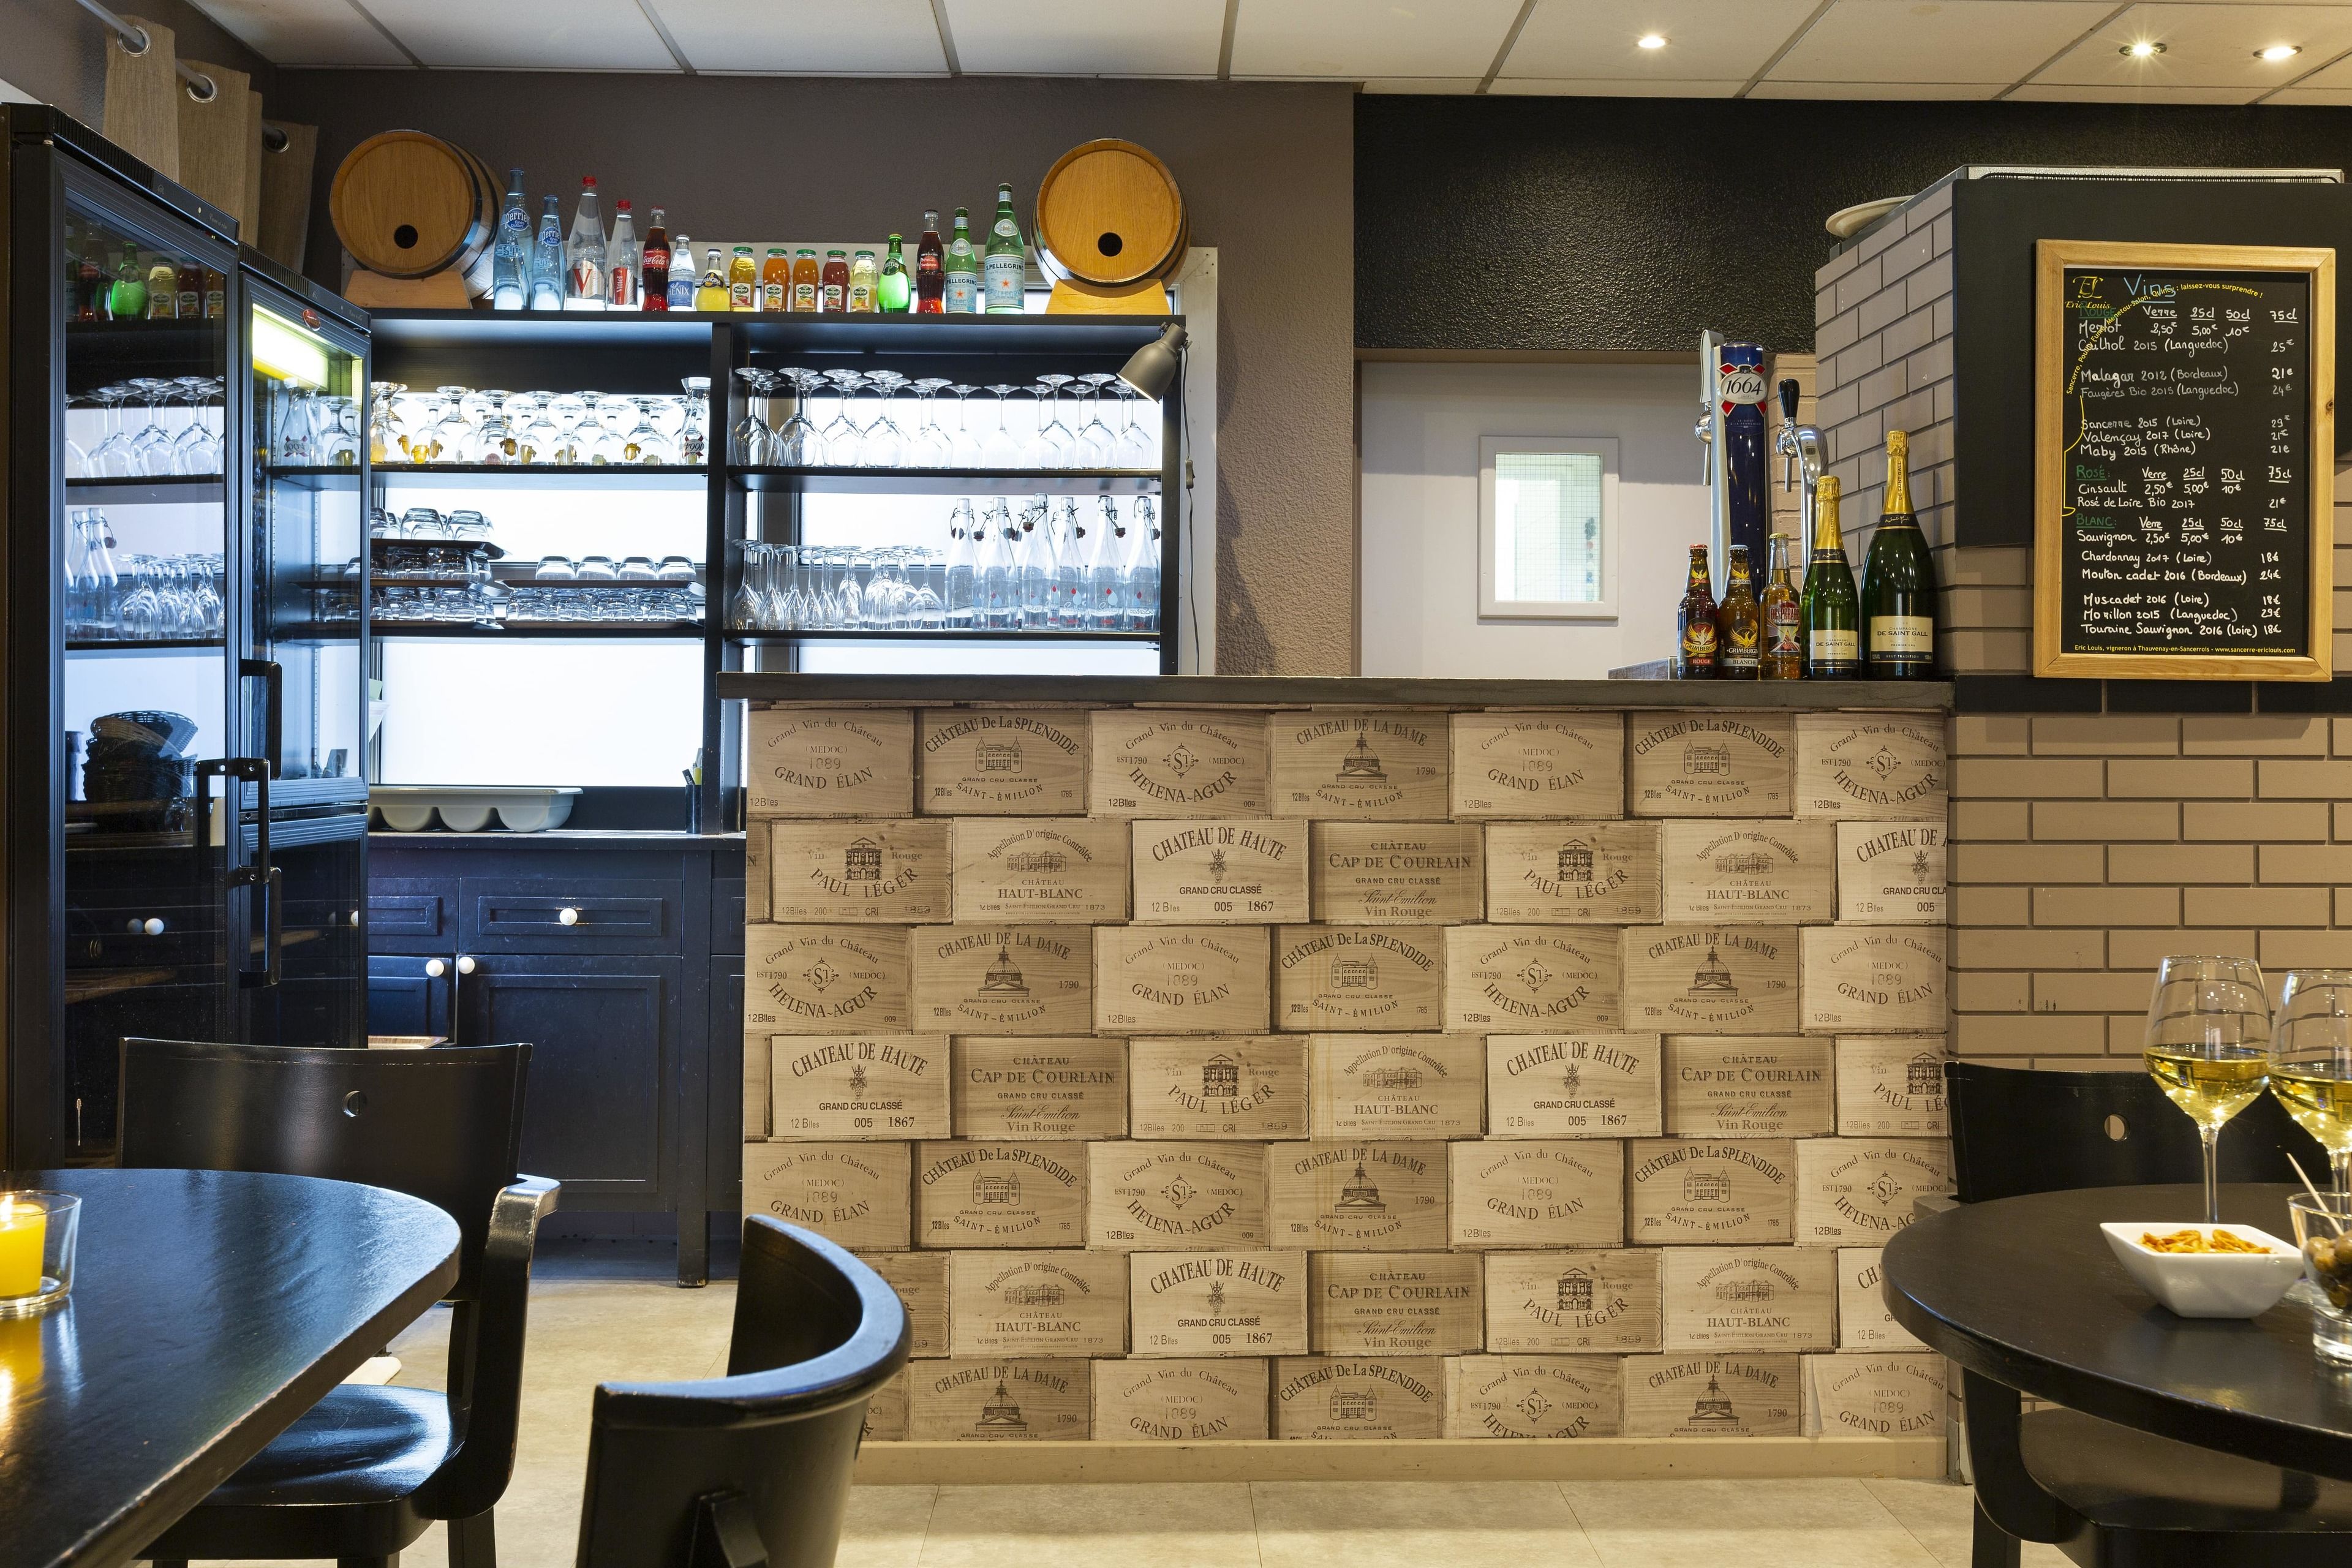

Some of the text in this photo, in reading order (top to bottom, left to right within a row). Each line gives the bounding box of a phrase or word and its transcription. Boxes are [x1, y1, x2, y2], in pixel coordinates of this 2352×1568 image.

[2124, 274, 2176, 298] Vins
[2143, 305, 2177, 317] Verre
[2133, 341, 2157, 350] 2015
[2165, 337, 2228, 358] (Languedoc)
[1725, 376, 1763, 395] 1664
[2081, 368, 2134, 388] Malagar
[2141, 371, 2166, 381] 2012
[2171, 366, 2228, 382] (Bordeaux)
[2081, 387, 2125, 402] Faugères
[2177, 381, 2239, 400] (Languedoc)
[2138, 417, 2157, 429] 2015
[2166, 415, 2201, 428] (Loire)
[2082, 431, 2141, 447] Valençay
[2146, 431, 2169, 440] 2017
[2174, 428, 2211, 440] (Loire)
[2081, 444, 2116, 461] Maby
[2124, 447, 2147, 456] 2015
[2154, 441, 2196, 456] (Rhône)
[2142, 466, 2168, 480] Verre
[2183, 466, 2204, 478] 25cl
[2221, 469, 2245, 480] 50cl
[2268, 466, 2292, 479] 75cl
[2078, 479, 2127, 494] Cinsault
[2078, 497, 2100, 507] Rosé
[2104, 497, 2116, 507] de
[2118, 497, 2143, 507] Loire
[2147, 497, 2166, 507] Bio
[2171, 500, 2195, 508] 2017
[2139, 516, 2163, 529] Verre
[2181, 518, 2204, 528] 25cl
[2220, 518, 2244, 528] 50cl
[2264, 518, 2286, 529] 75cl
[2076, 530, 2137, 548] Sauvignon
[2081, 551, 2140, 568] Chardonnay
[2146, 553, 2169, 562] 2017
[2176, 551, 2212, 566] (Loire)
[2082, 568, 2122, 579] Mouton
[2126, 569, 2160, 581] cadet
[2164, 570, 2186, 581] 2016
[2192, 568, 2247, 586] (Bordeaux)
[2084, 593, 2142, 606] Muscadet
[2147, 595, 2166, 604] 2016
[2174, 592, 2209, 608] (Loire)
[2136, 610, 2160, 619] 2015
[2170, 608, 2237, 625] (Languedoc)
[2081, 624, 2132, 635] Touraine
[2136, 622, 2193, 639] Sauvignon
[2199, 625, 2223, 635] 2016
[2227, 624, 2258, 638] (Loire)
[925, 716, 1079, 756] CHÂTEAU De La SPLENDIDE
[1152, 827, 1287, 861] CHATEAU DE HAUTE
[1329, 853, 1471, 869] CAP DE COURLAIN
[1231, 884, 1262, 894] CLASSÉ
[1523, 869, 1629, 899] PAUL LÉGER
[998, 889, 1083, 899] HAUT-BLANC
[1214, 902, 1232, 911] 005
[1248, 900, 1274, 911] 1867
[1366, 907, 1432, 919] Vin Rouge
[1507, 1041, 1640, 1076] CHATEAU DE HAUTE
[1487, 1197, 1584, 1220] GRAND ÉLAN
[995, 1322, 1081, 1332] HAUT-BLANC
[1707, 1317, 1790, 1327] HAUT-BLANC
